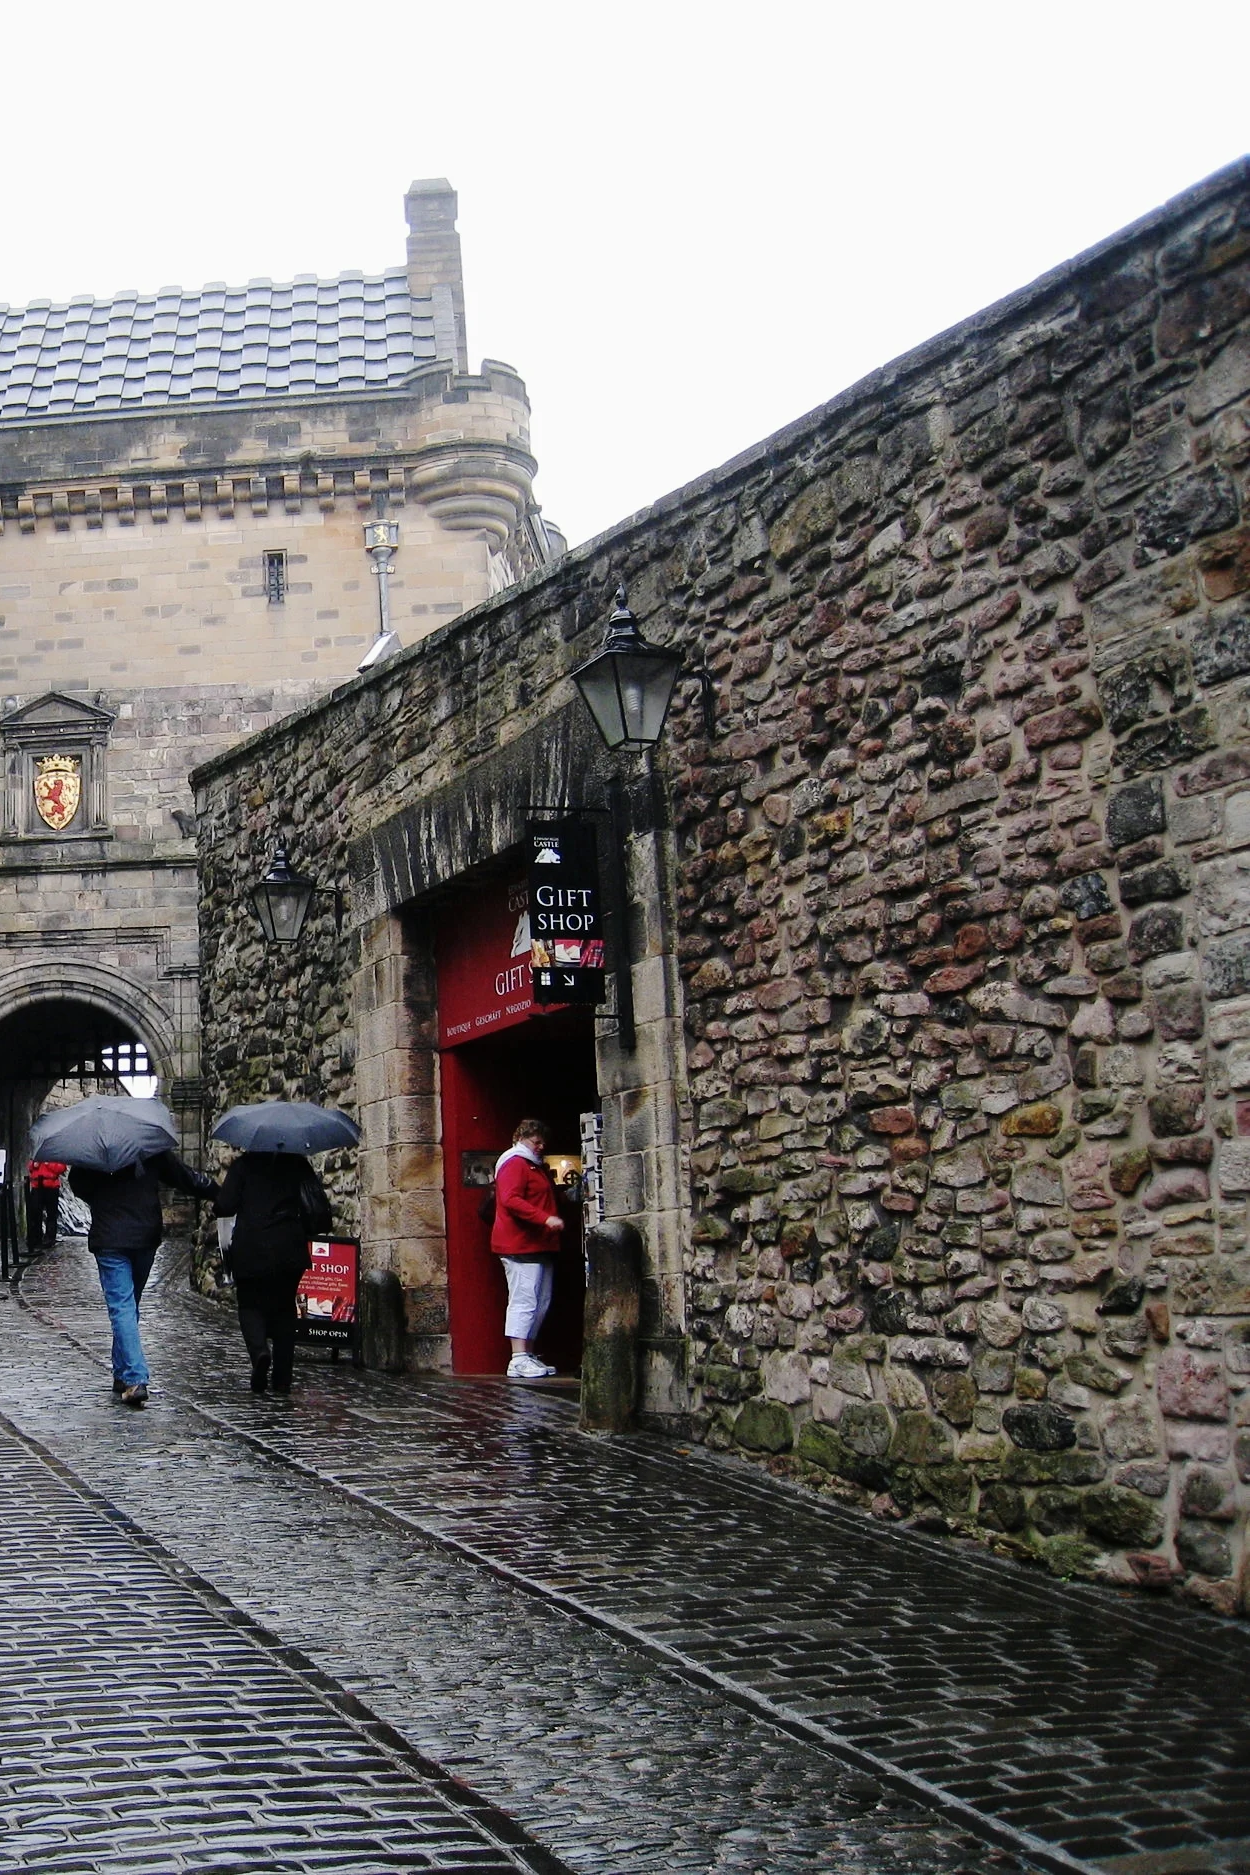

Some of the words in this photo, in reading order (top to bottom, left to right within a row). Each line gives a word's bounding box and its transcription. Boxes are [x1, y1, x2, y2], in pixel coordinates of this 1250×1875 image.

[536, 885, 592, 907] GIFT
[537, 913, 594, 931] SHOP
[495, 964, 525, 996] GIFT
[320, 1263, 349, 1274] SHOP
[308, 1328, 328, 1337] SHOP
[329, 1330, 348, 1338] OPEN
